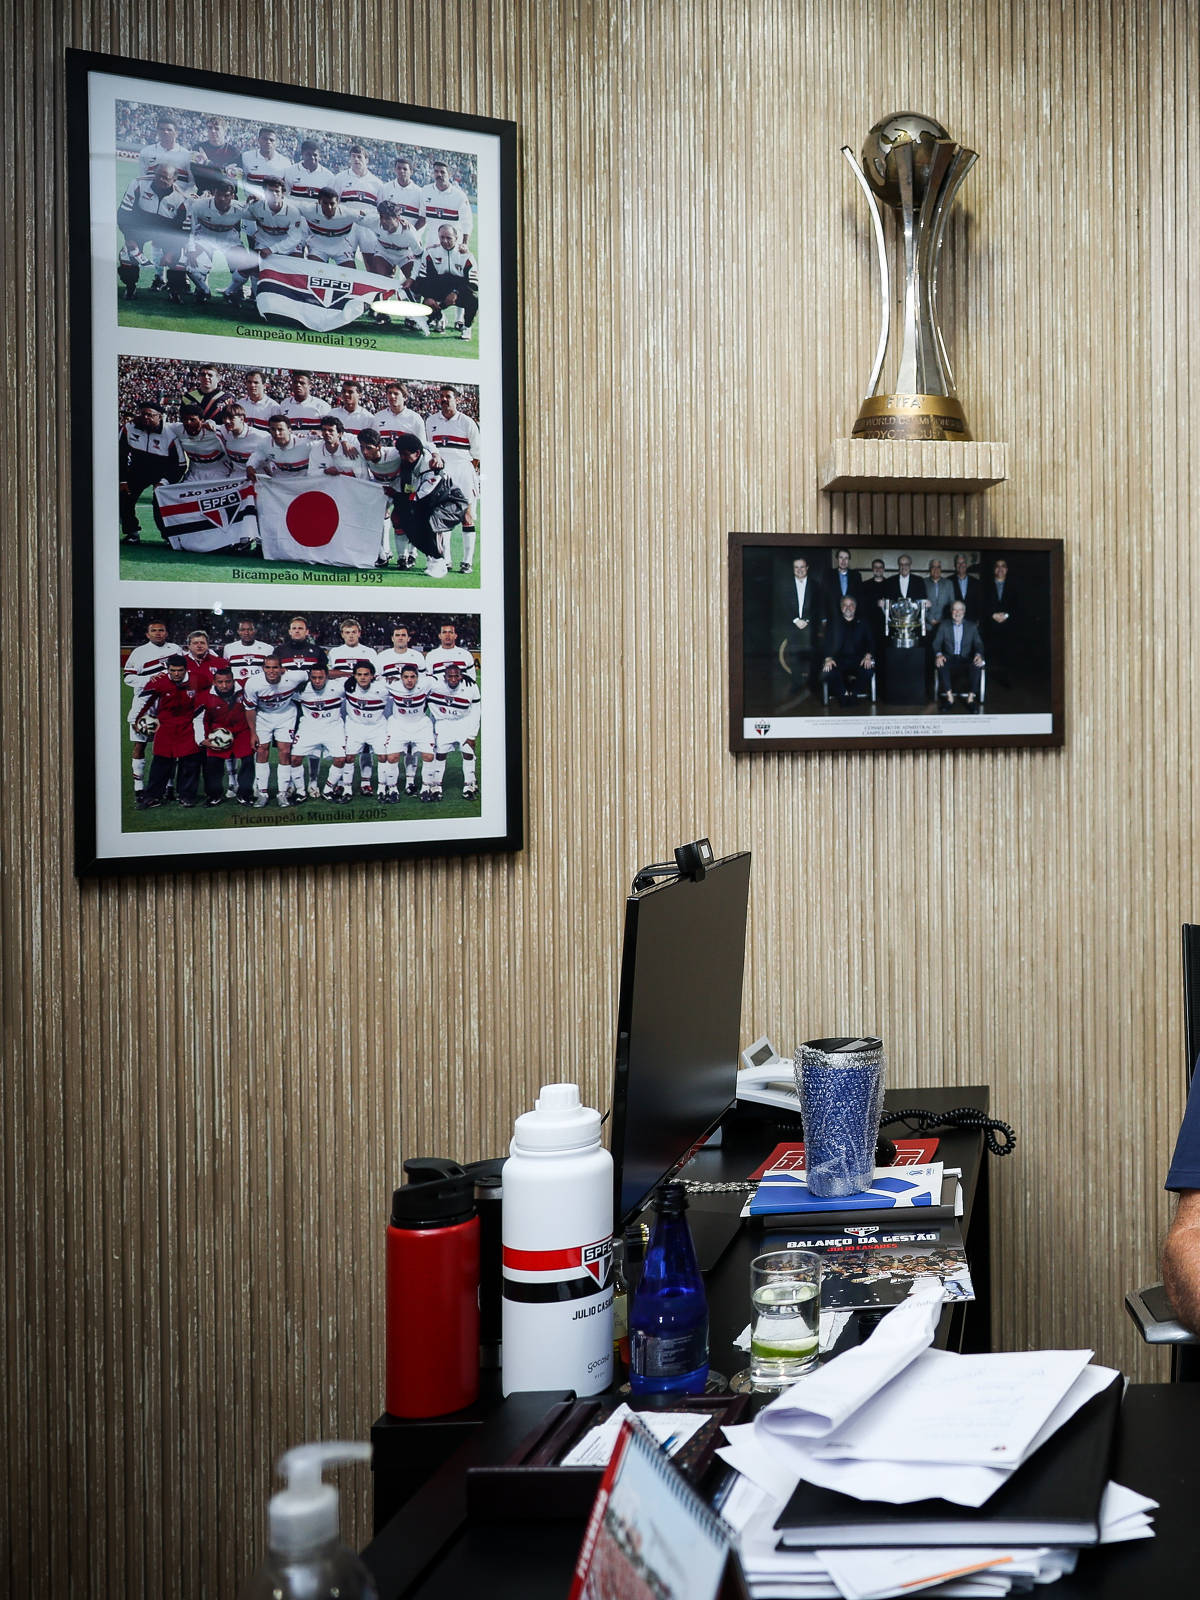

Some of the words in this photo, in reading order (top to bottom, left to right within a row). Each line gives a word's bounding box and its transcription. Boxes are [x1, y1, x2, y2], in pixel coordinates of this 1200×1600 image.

[311, 278, 350, 290] SPFC
[236, 326, 292, 340] Campeão
[296, 331, 344, 345] Mundial
[349, 337, 377, 348] 1992
[887, 397, 921, 408] FIFA
[204, 482, 239, 494] PAULO
[203, 493, 237, 510] SPFC
[232, 569, 299, 582] Bicampeão
[302, 571, 350, 582] Mundial
[354, 573, 384, 583] 1993
[231, 812, 303, 825] Tricampeão
[307, 809, 354, 822] Mundial
[358, 808, 388, 820] 2005
[787, 1238, 852, 1248] BALANÇO
[858, 1236, 878, 1245] DA
[883, 1233, 936, 1243] GESTÃO
[586, 1241, 612, 1260] SPFC
[572, 1306, 596, 1321] JULIO
